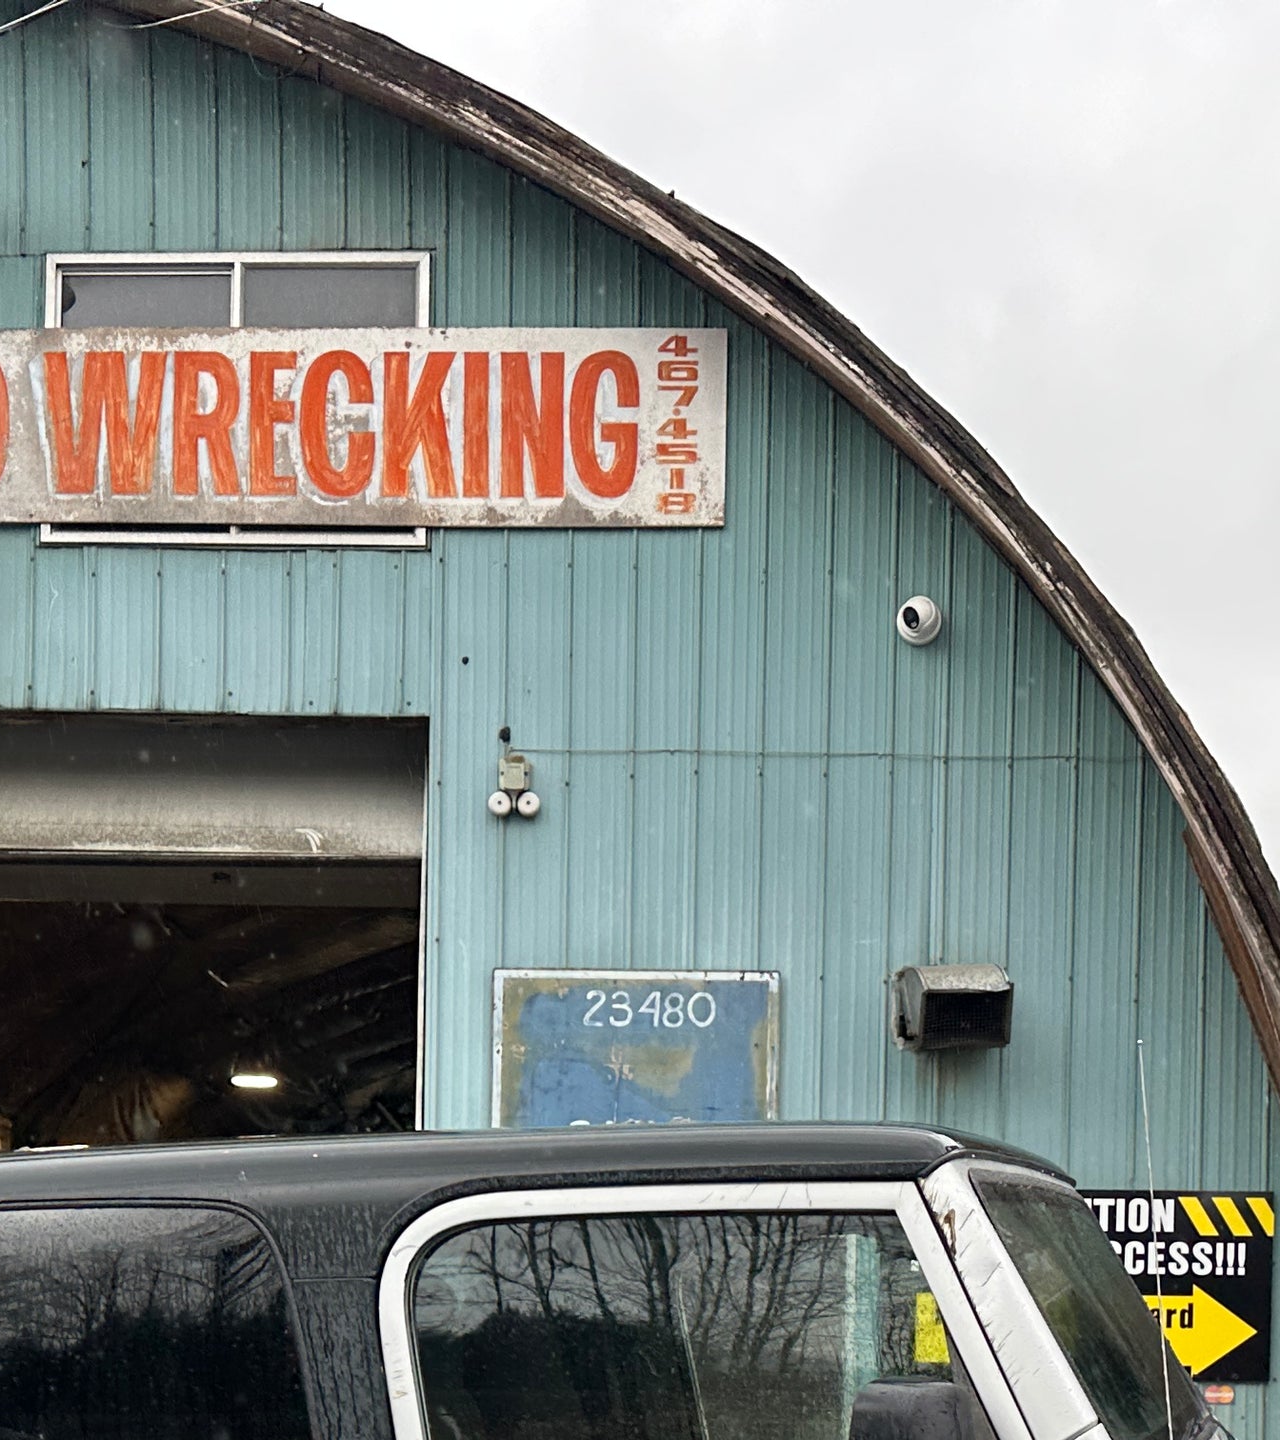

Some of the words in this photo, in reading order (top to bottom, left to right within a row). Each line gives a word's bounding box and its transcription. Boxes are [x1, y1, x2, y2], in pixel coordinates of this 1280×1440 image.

[42, 348, 642, 500] WRECKING
[582, 989, 717, 1028] 23480
[1083, 1197, 1175, 1234] TION
[1109, 1240, 1247, 1276] CESS!!!
